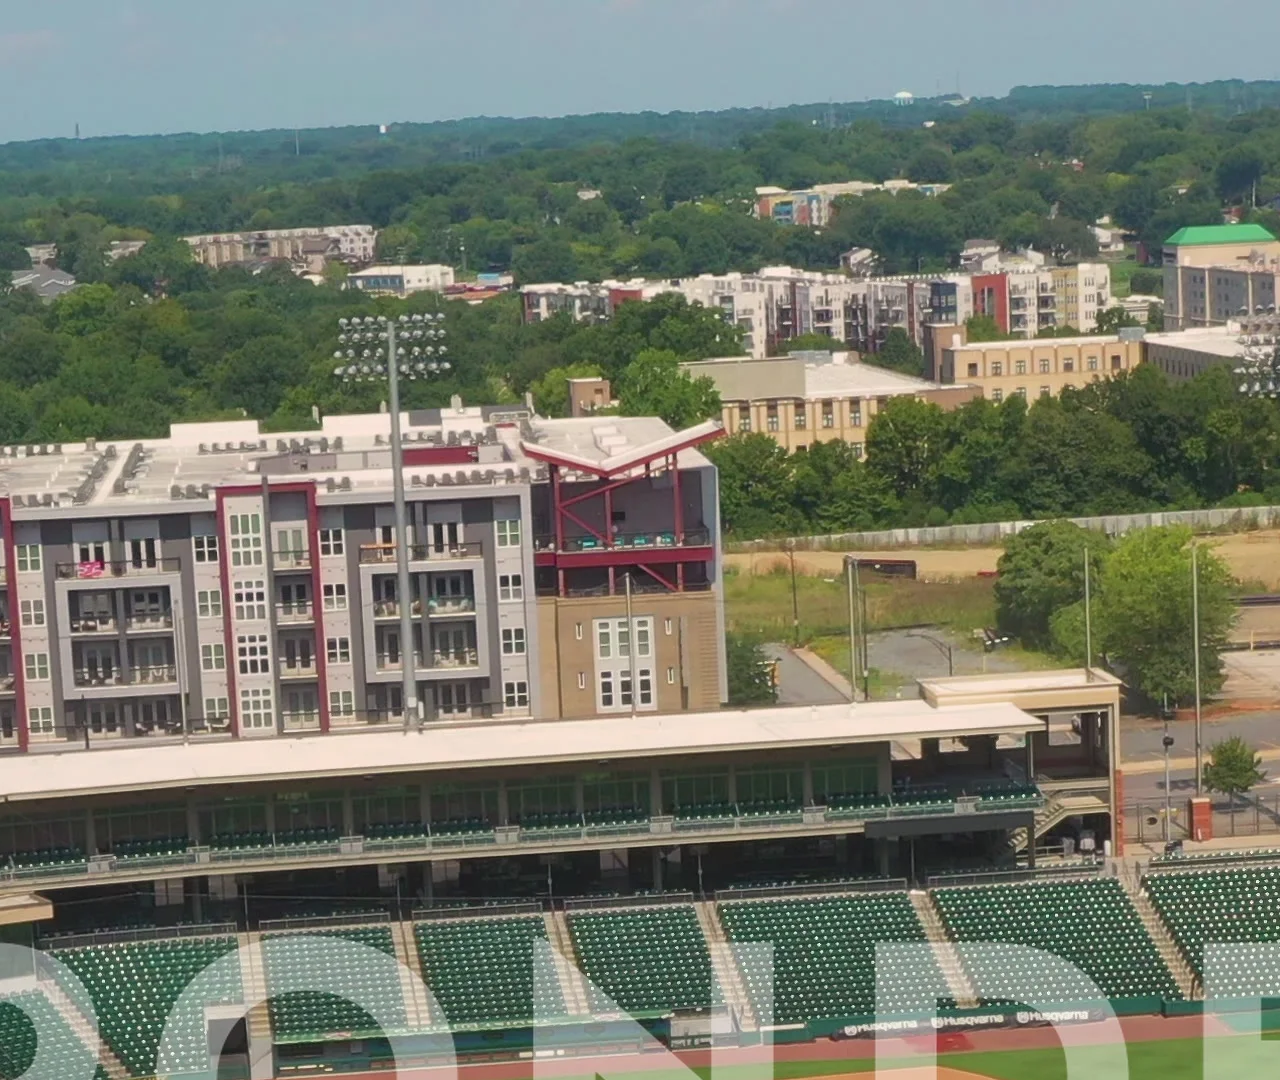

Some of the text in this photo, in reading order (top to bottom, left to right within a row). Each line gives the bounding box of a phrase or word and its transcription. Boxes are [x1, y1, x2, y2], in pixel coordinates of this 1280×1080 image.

[943, 1013, 1004, 1028] Husqvarna
[1029, 1010, 1089, 1022] Husqvarna
[856, 1018, 918, 1034] Husqvarna
